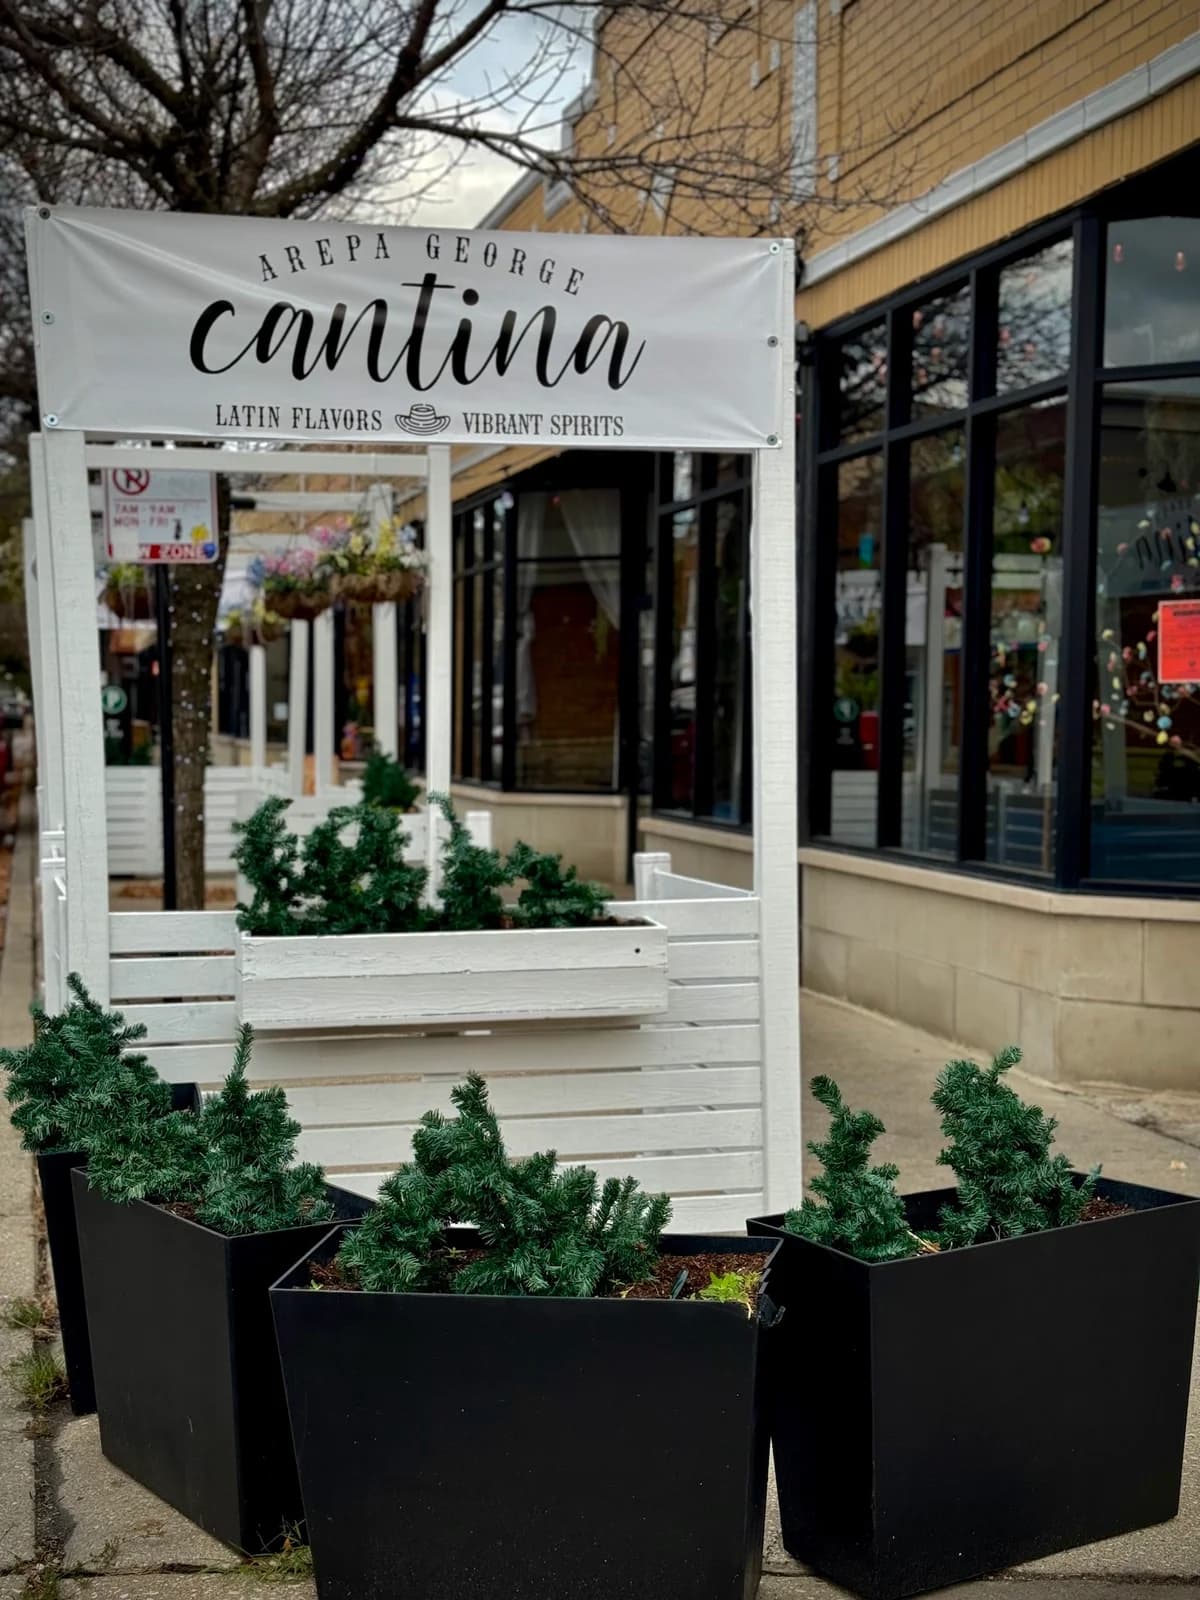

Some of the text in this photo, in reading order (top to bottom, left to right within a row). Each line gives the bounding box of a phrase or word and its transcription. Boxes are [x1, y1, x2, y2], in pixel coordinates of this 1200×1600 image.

[258, 232, 585, 296] AREPA GEORGE
[189, 272, 647, 392] cantina
[215, 404, 625, 437] LATIN FLAVORS VIBRANT SPIRITS
[115, 503, 139, 514] 7AM
